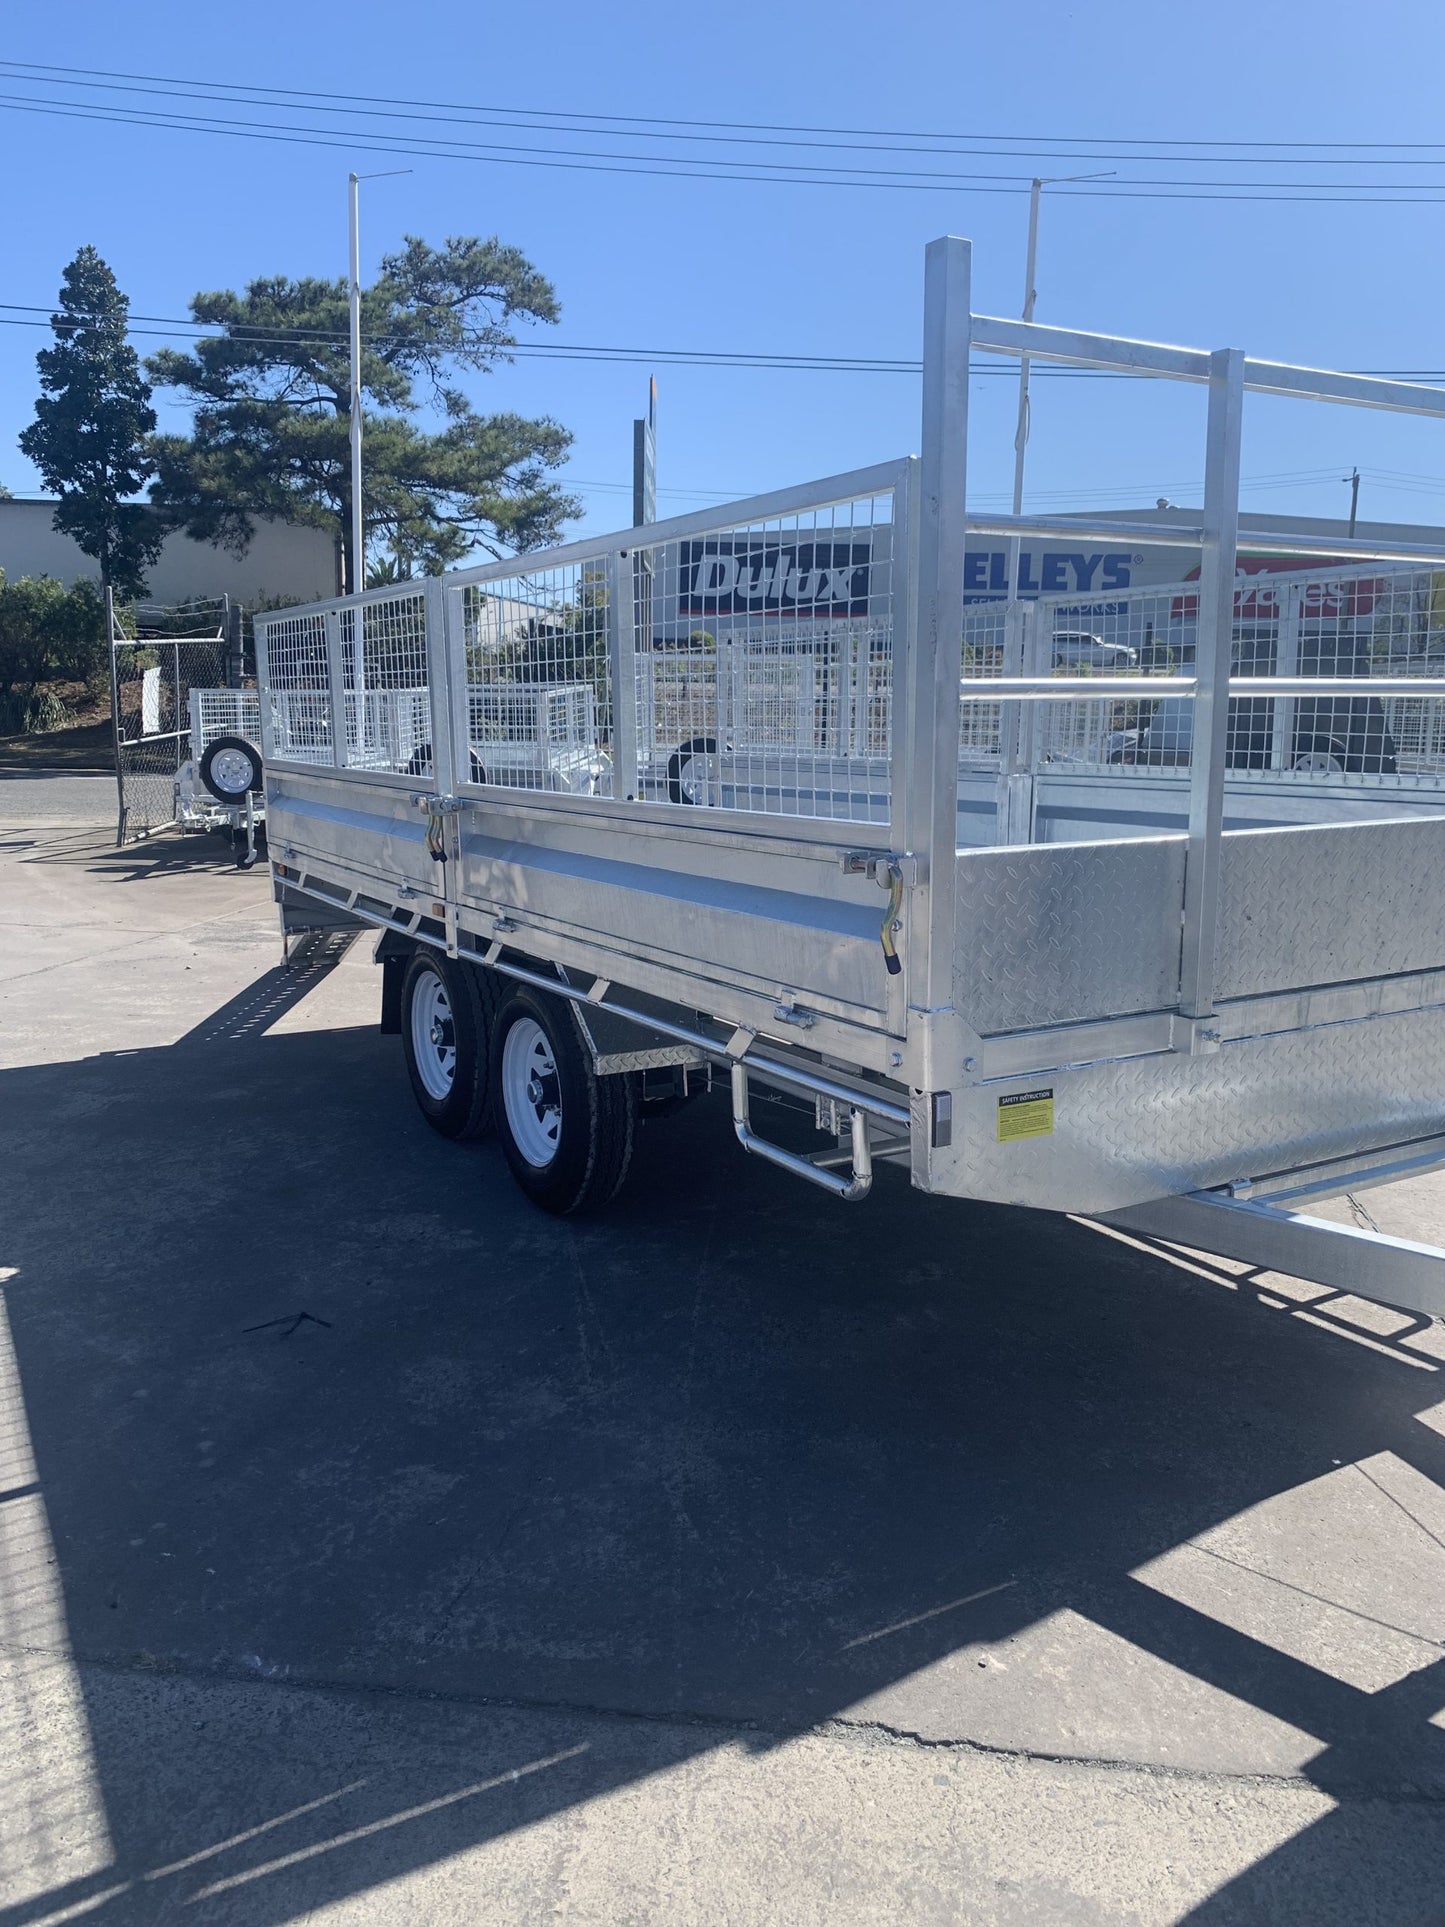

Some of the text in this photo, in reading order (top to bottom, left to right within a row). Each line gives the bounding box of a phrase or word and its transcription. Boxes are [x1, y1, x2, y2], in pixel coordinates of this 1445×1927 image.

[693, 554, 857, 599] Dulux
[963, 553, 1131, 591] ELLEYS
[1002, 1092, 1050, 1104] SAFETY INSTRUCTION
